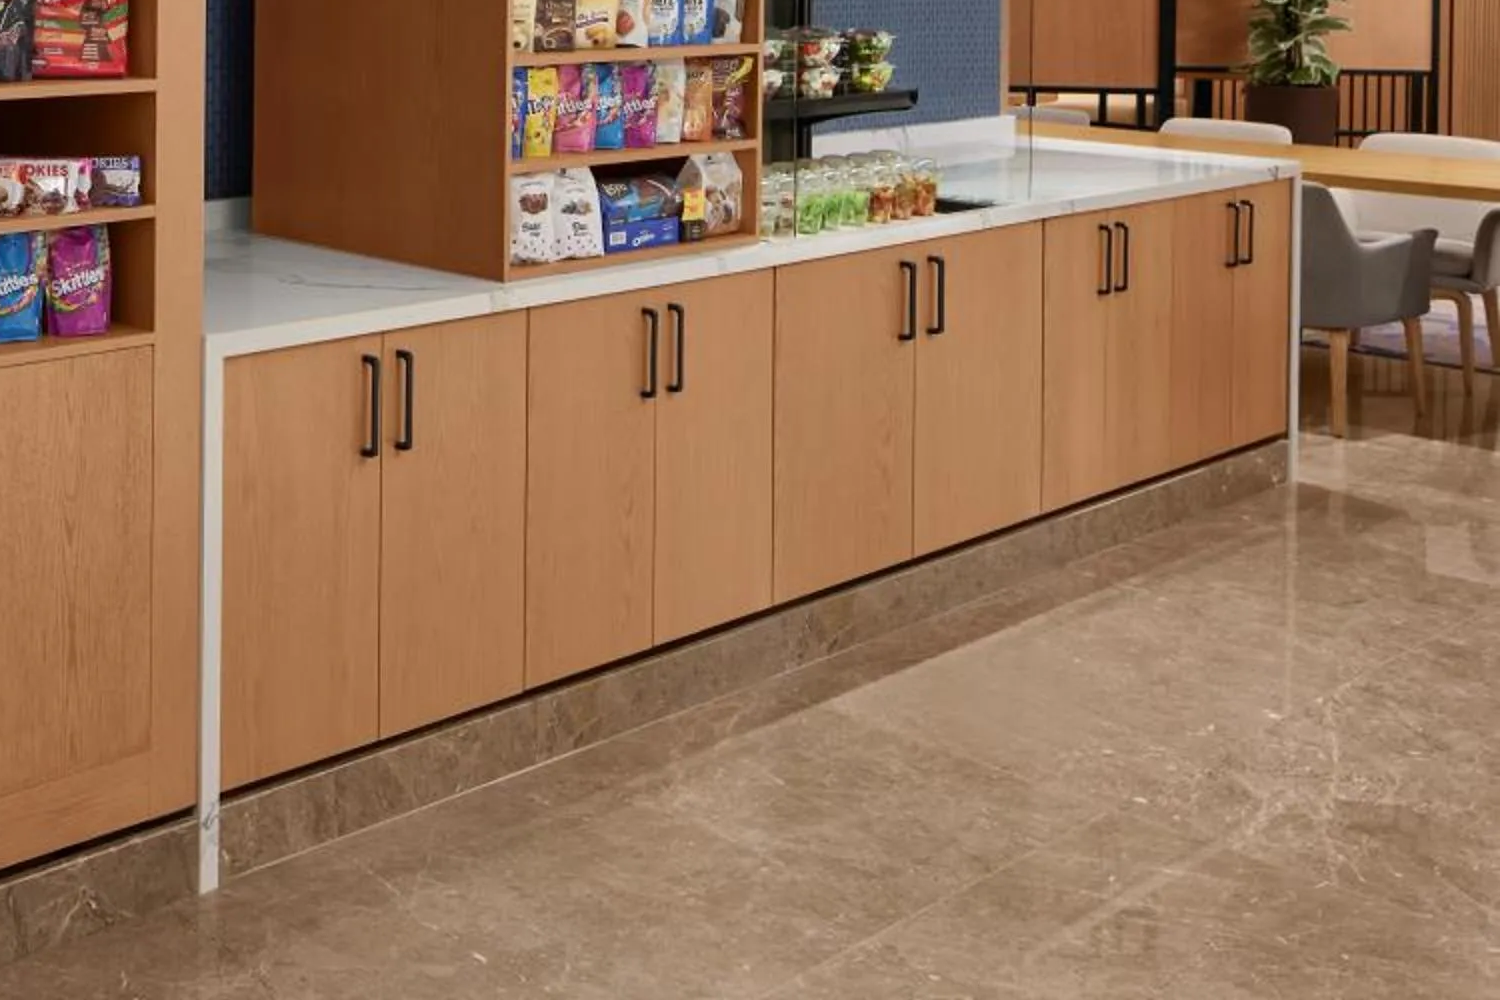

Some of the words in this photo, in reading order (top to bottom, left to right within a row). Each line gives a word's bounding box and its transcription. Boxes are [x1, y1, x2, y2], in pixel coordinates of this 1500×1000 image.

[91, 157, 129, 170] OKIES
[25, 164, 69, 177] OKIES
[51, 269, 106, 297] Skittles
